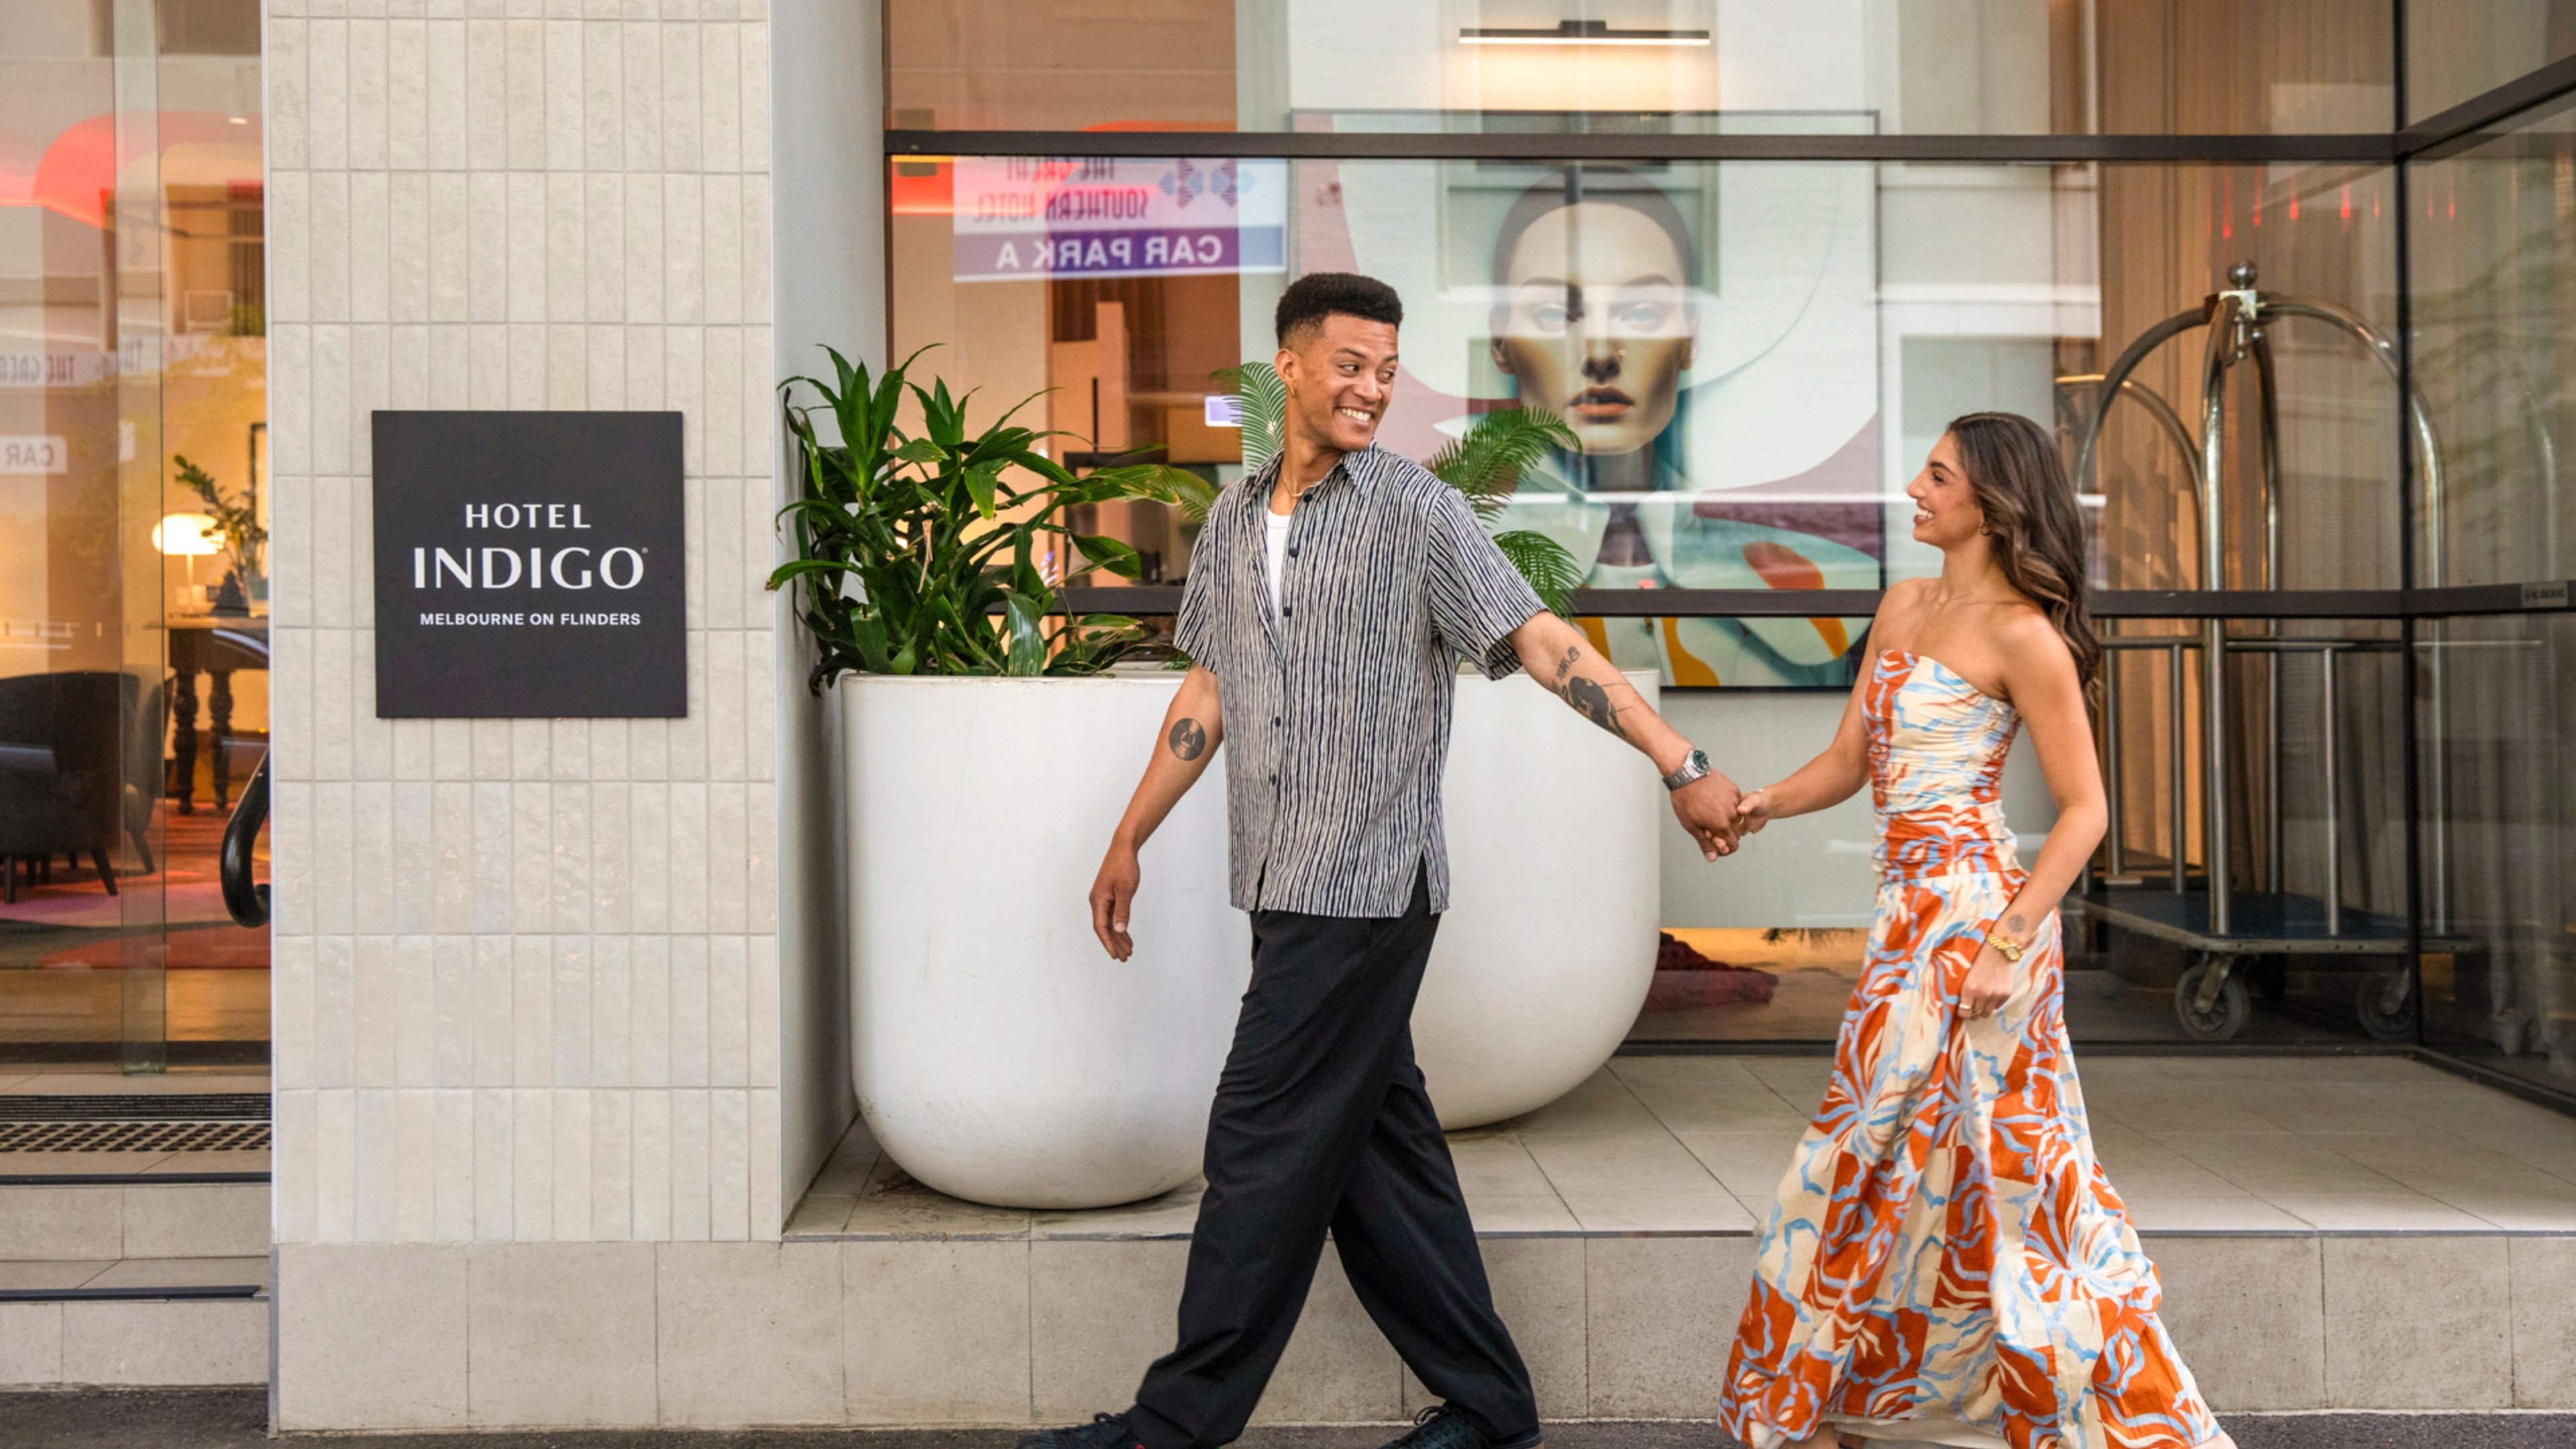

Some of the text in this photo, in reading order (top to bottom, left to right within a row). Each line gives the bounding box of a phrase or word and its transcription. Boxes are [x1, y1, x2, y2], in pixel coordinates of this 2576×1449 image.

[465, 503, 591, 529] HOTEL
[413, 547, 645, 590] INDIGO
[420, 613, 641, 626] MELBOURNE ON FLINDERS
